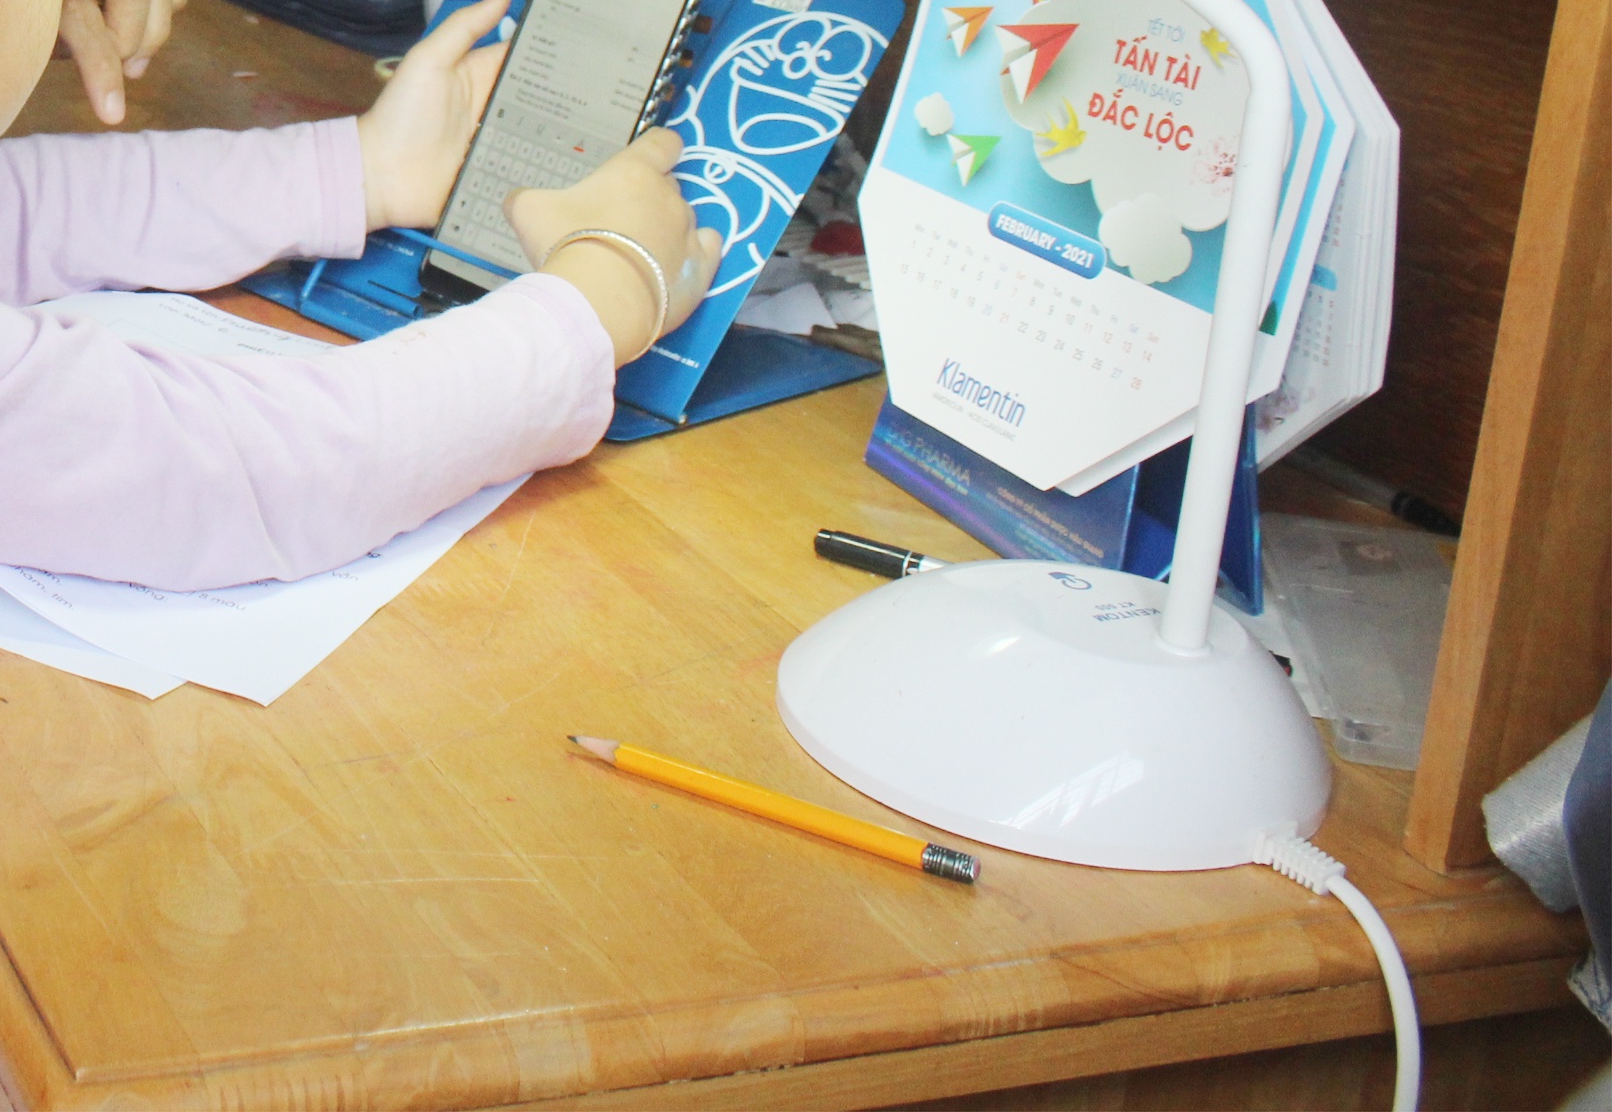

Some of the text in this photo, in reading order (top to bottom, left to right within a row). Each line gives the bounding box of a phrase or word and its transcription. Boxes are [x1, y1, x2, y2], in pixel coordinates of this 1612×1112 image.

[1114, 35, 1202, 90] TẤN TÀI
[1116, 73, 1184, 106] XUÂN SANG
[1087, 88, 1194, 151] ĐẮC LỘC
[995, 213, 1057, 251] FEBRUARY
[1061, 243, 1095, 268] 2021
[936, 357, 1026, 428] Klamentin
[913, 435, 972, 486] PHARMA
[1092, 607, 1162, 622] KENTOM
